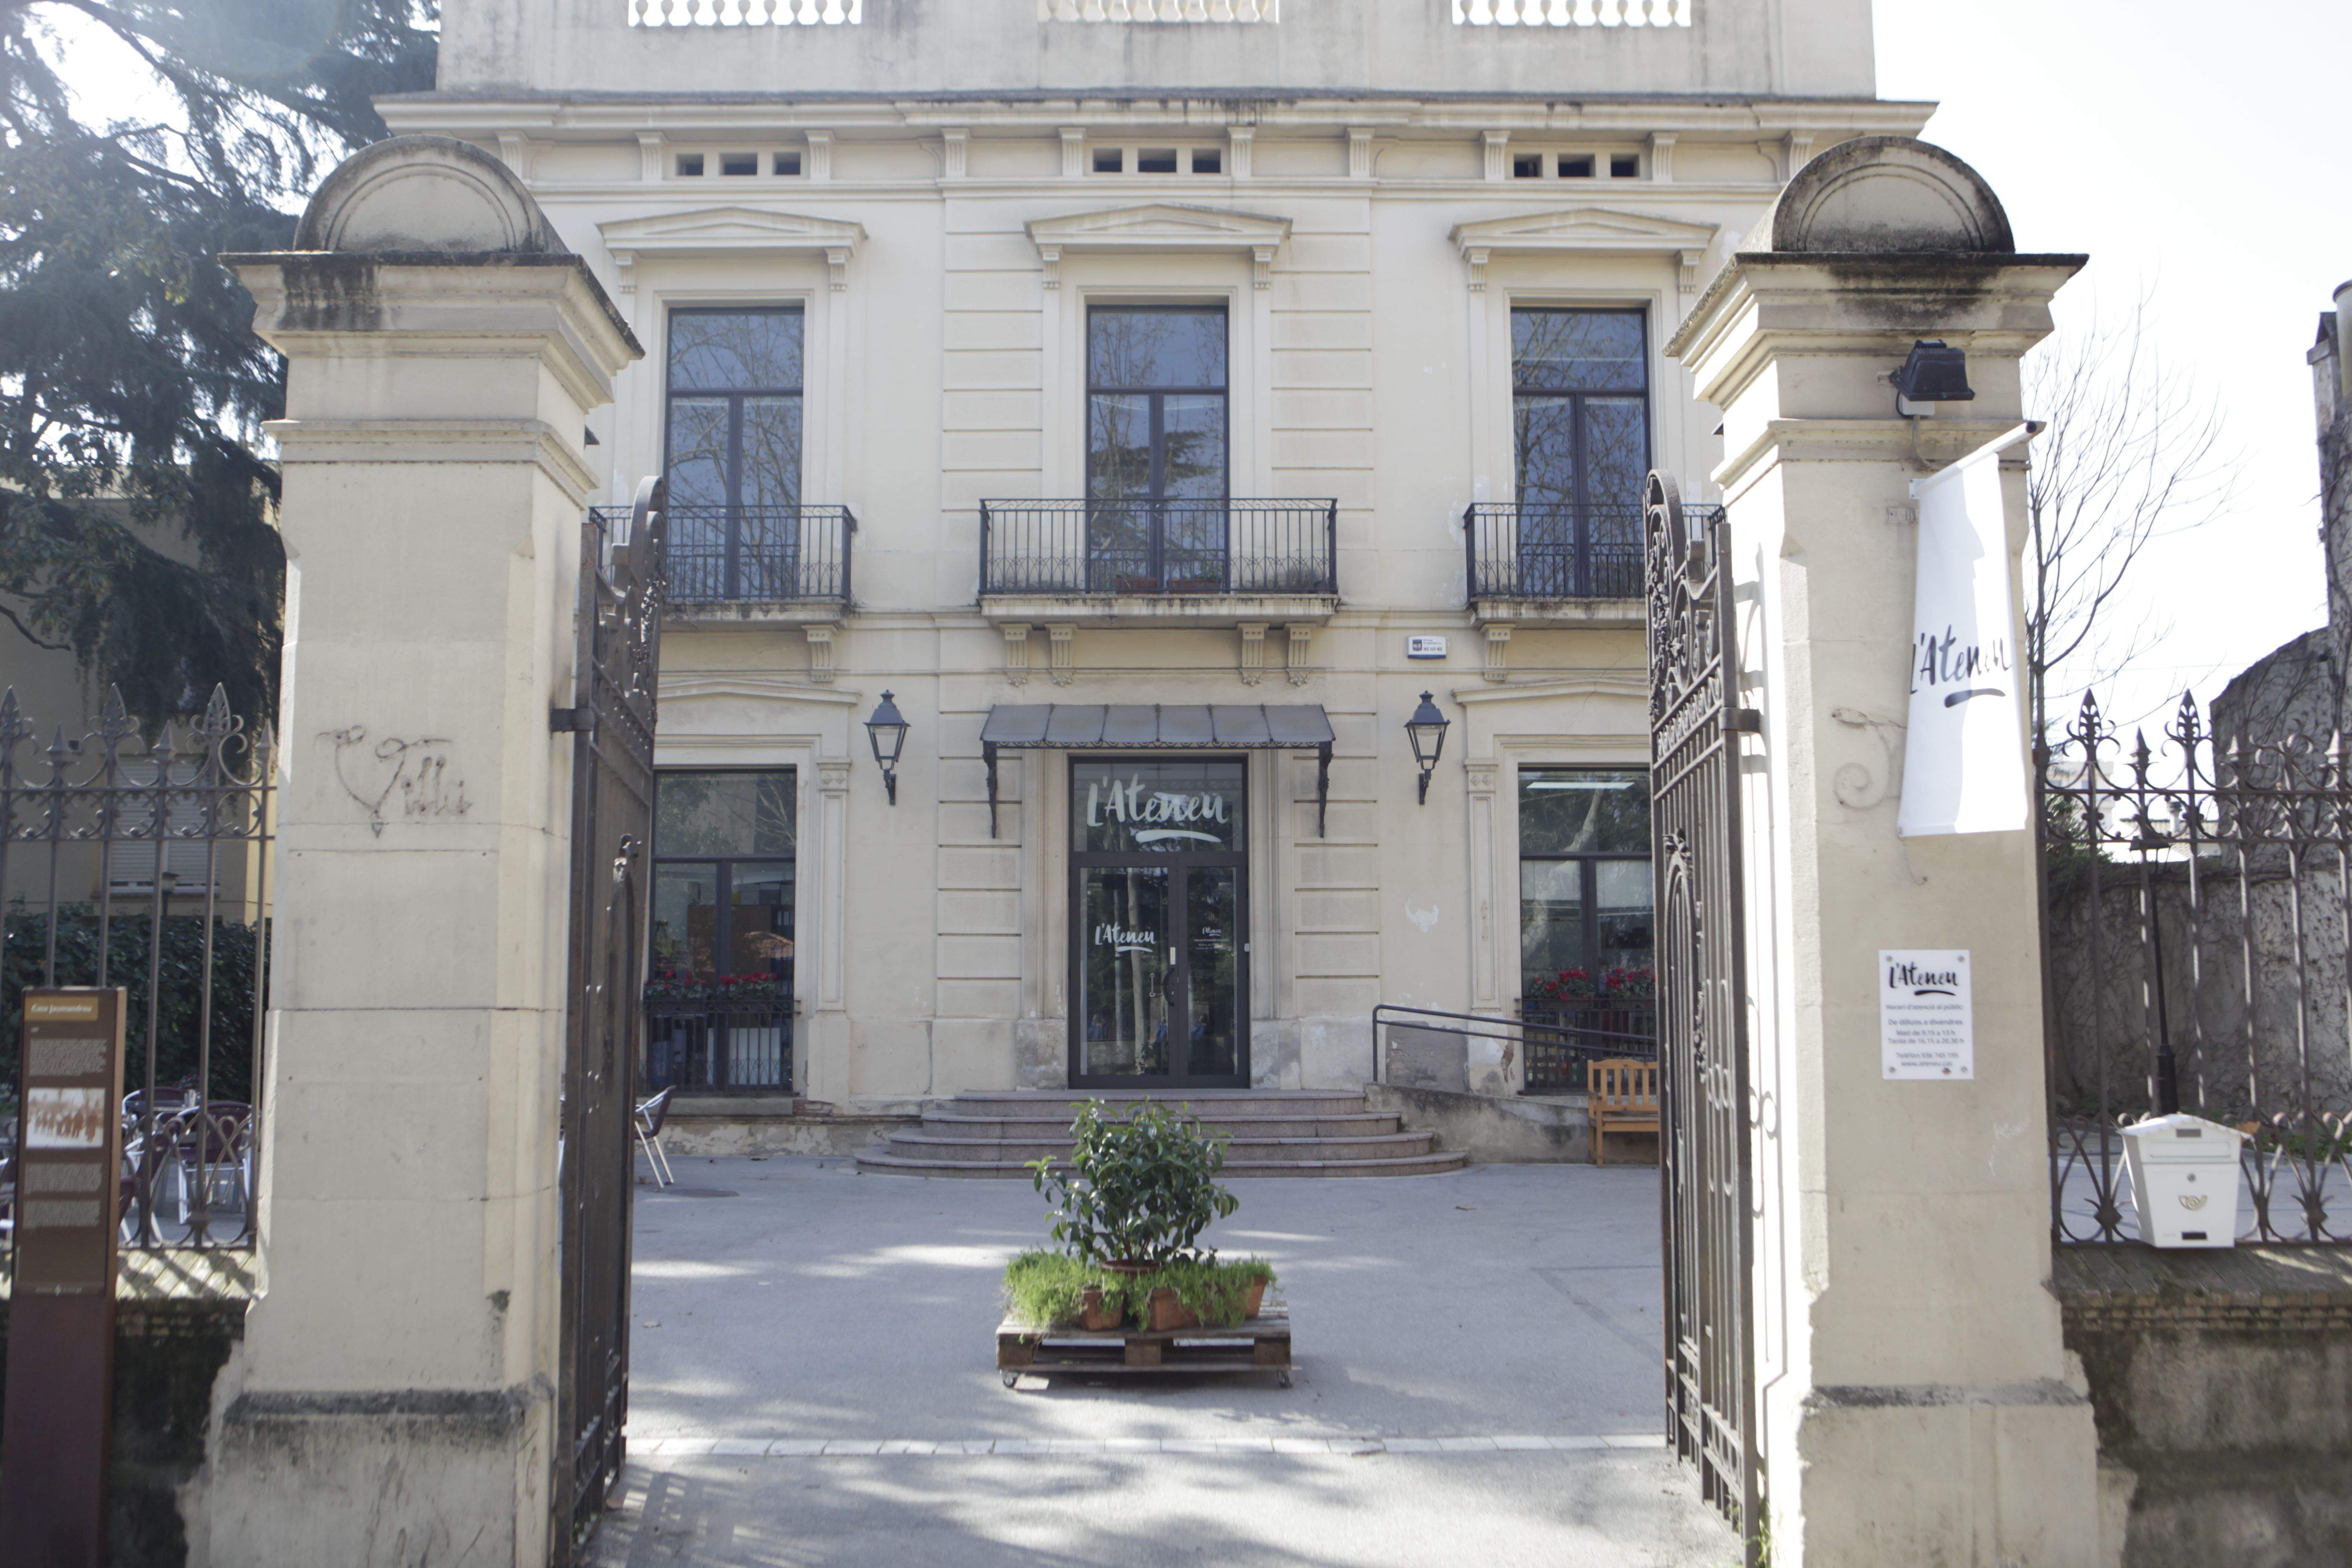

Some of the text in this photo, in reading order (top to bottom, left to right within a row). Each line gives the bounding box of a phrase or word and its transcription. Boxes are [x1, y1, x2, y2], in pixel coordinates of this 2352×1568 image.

[1910, 624, 2013, 695] L'Ateneu
[1087, 773, 1229, 827] L'Ateneu
[1095, 921, 1157, 946] L'Ateneu
[1890, 961, 1958, 988] L'Ateneu
